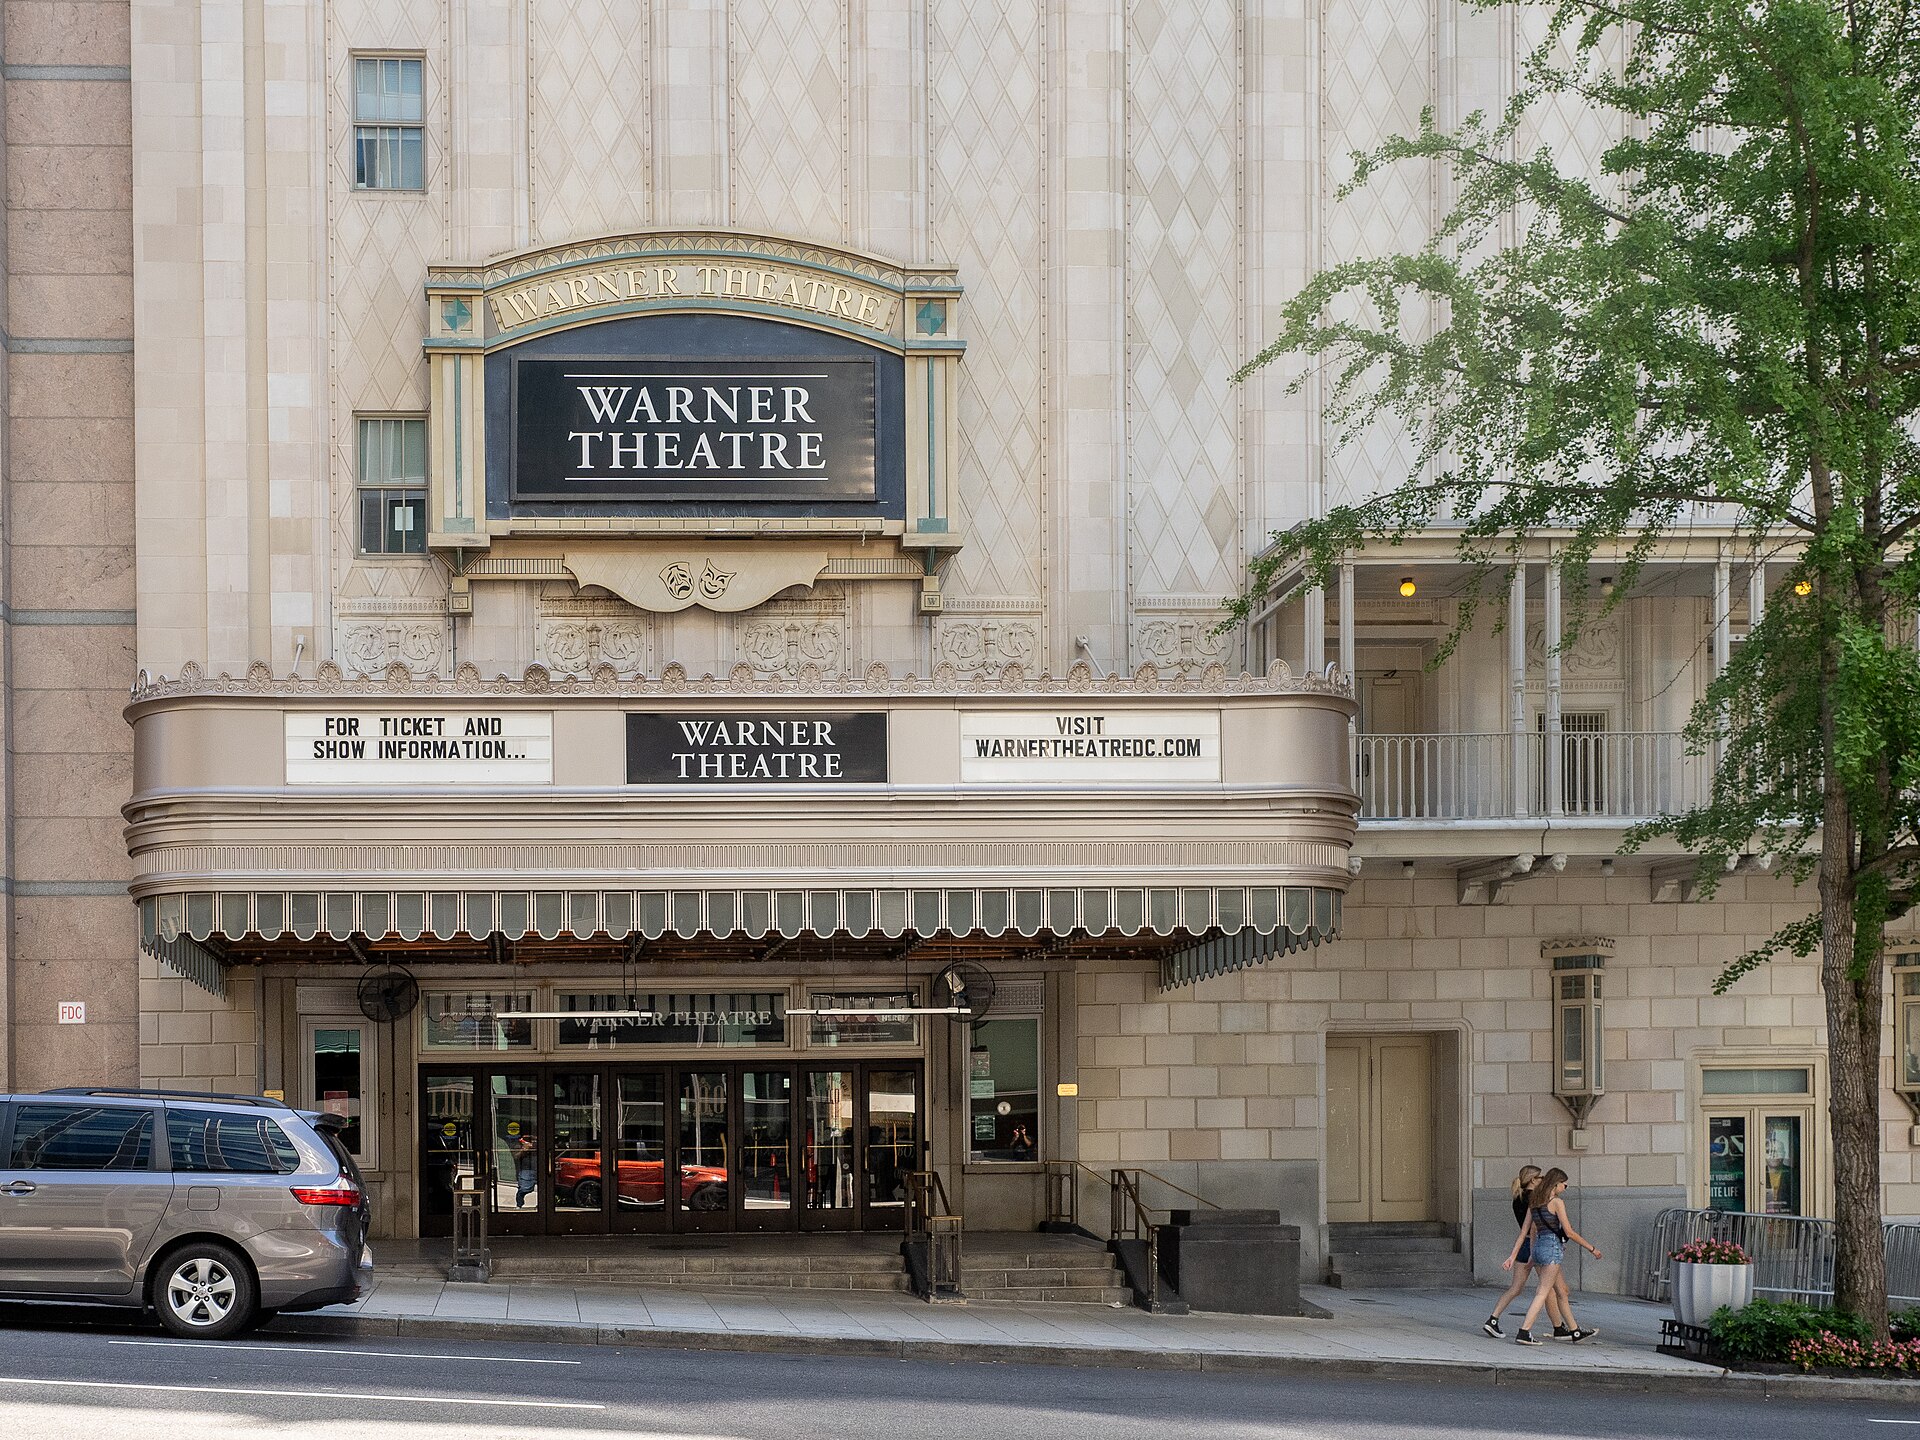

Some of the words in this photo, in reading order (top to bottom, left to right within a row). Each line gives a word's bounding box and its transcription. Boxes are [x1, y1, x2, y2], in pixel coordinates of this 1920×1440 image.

[503, 267, 681, 321] WARNER
[697, 266, 883, 326] THEATRE
[576, 386, 816, 424] WARNER
[567, 431, 827, 470] THEATRE
[325, 717, 360, 737] FOR
[379, 717, 446, 737] TICKET
[464, 717, 502, 737] AND
[677, 720, 836, 747] WARNER
[1055, 716, 1105, 735] VISIT
[313, 740, 366, 760] SHOW
[377, 740, 526, 760] INFORMATION...
[975, 738, 1201, 758] WARNERTHEATREDC.COM
[671, 752, 844, 779] THEATRE
[61, 1005, 82, 1020] FDC
[669, 1010, 772, 1026] THEATRE
[1711, 1186, 1722, 1198] ITE
[1723, 1186, 1739, 1198] LIFE
